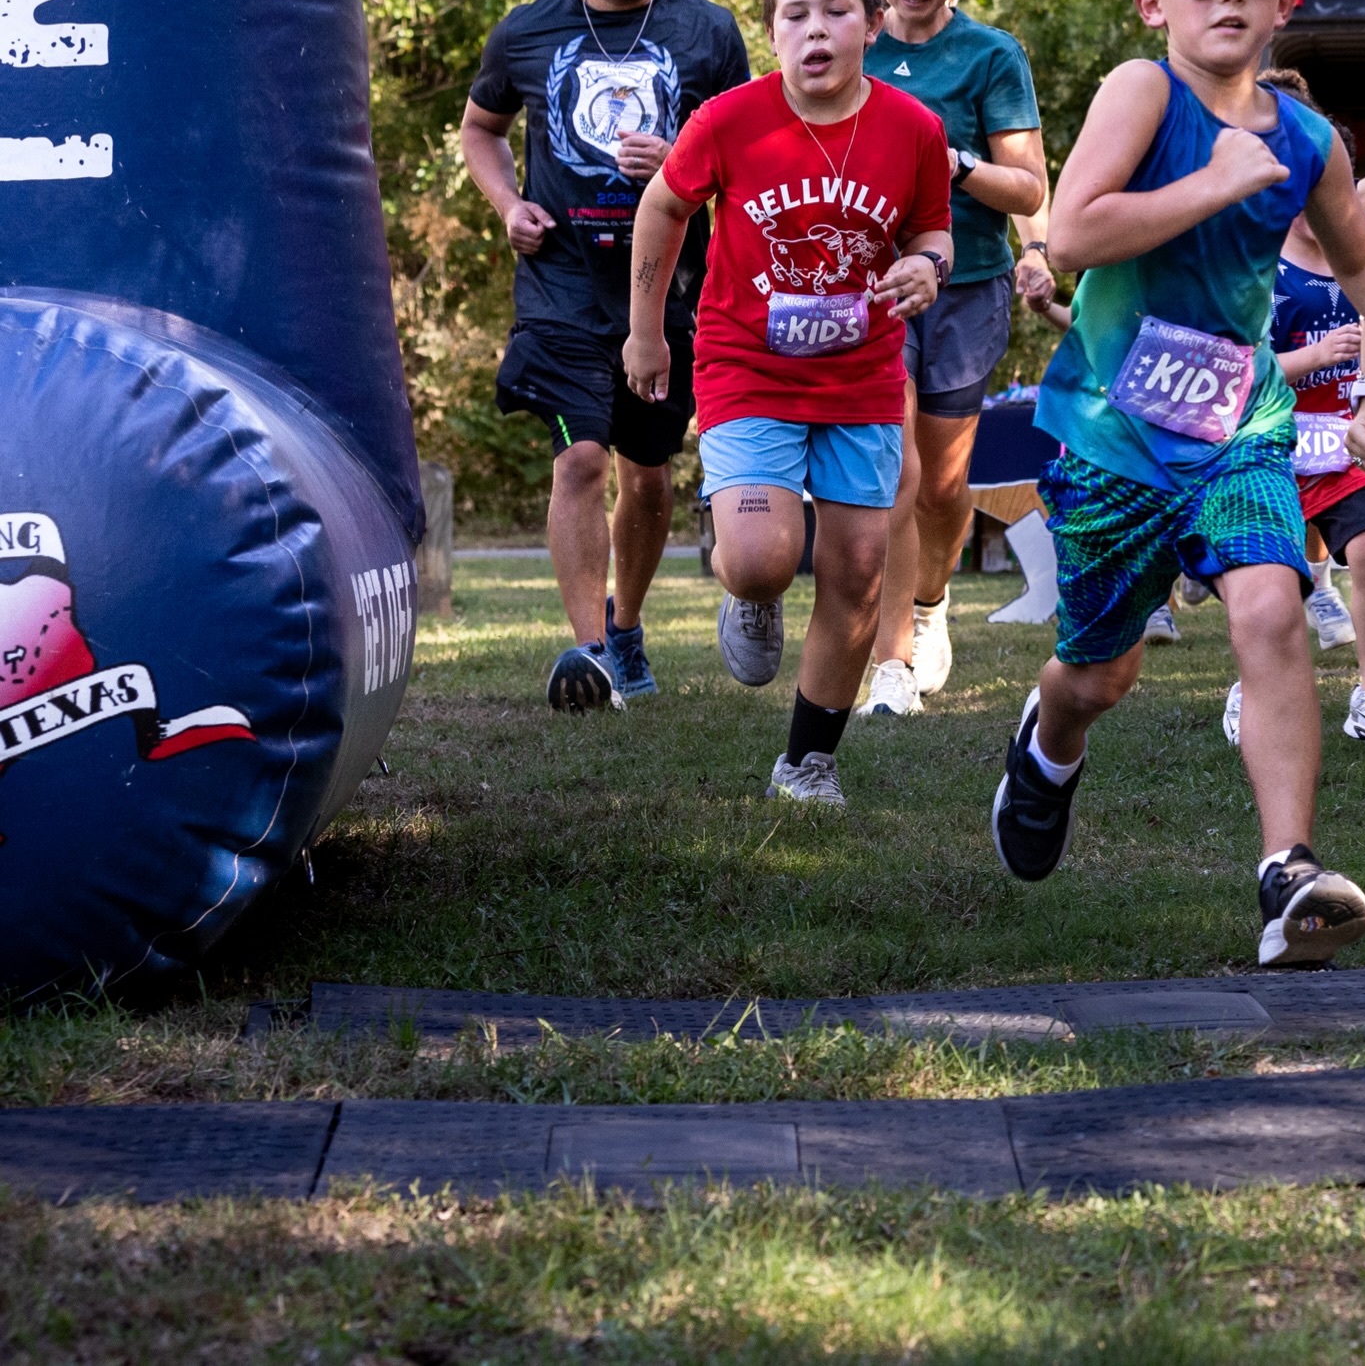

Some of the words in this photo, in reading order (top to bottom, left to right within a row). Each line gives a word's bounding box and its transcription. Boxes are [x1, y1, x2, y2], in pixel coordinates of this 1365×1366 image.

[783, 296, 818, 309] NIGHT
[820, 296, 855, 309] MOVES
[830, 308, 855, 318] TROT
[787, 315, 860, 345] KIDS
[1158, 325, 1203, 349] NIGHT
[1213, 357, 1246, 374] TROT
[1144, 352, 1242, 416] KIDS
[382, 560, 413, 684] OFF
